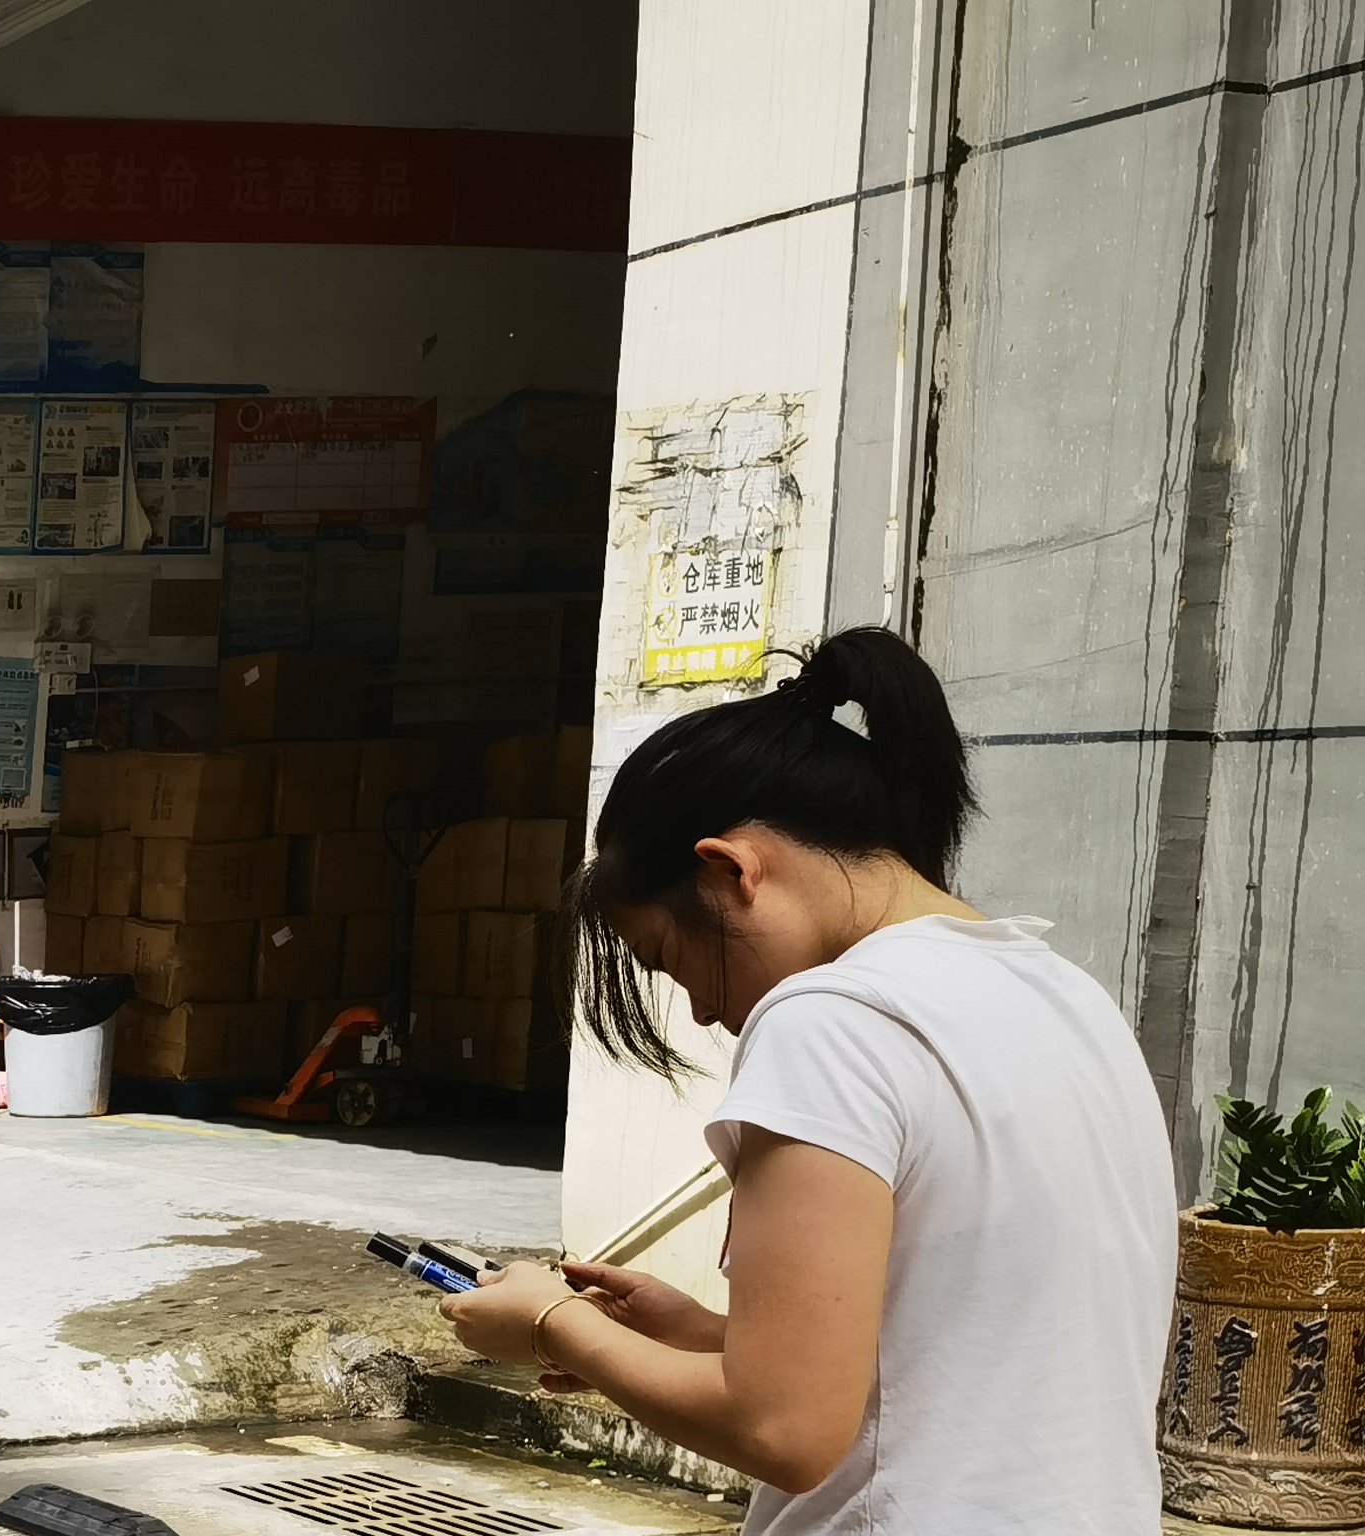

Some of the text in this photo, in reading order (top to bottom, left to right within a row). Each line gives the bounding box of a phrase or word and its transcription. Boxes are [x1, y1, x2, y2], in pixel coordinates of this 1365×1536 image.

[8, 153, 415, 217] 珍爱生命 远离毒品
[682, 554, 764, 593] 仓库重地
[678, 599, 760, 637] 严禁烟火
